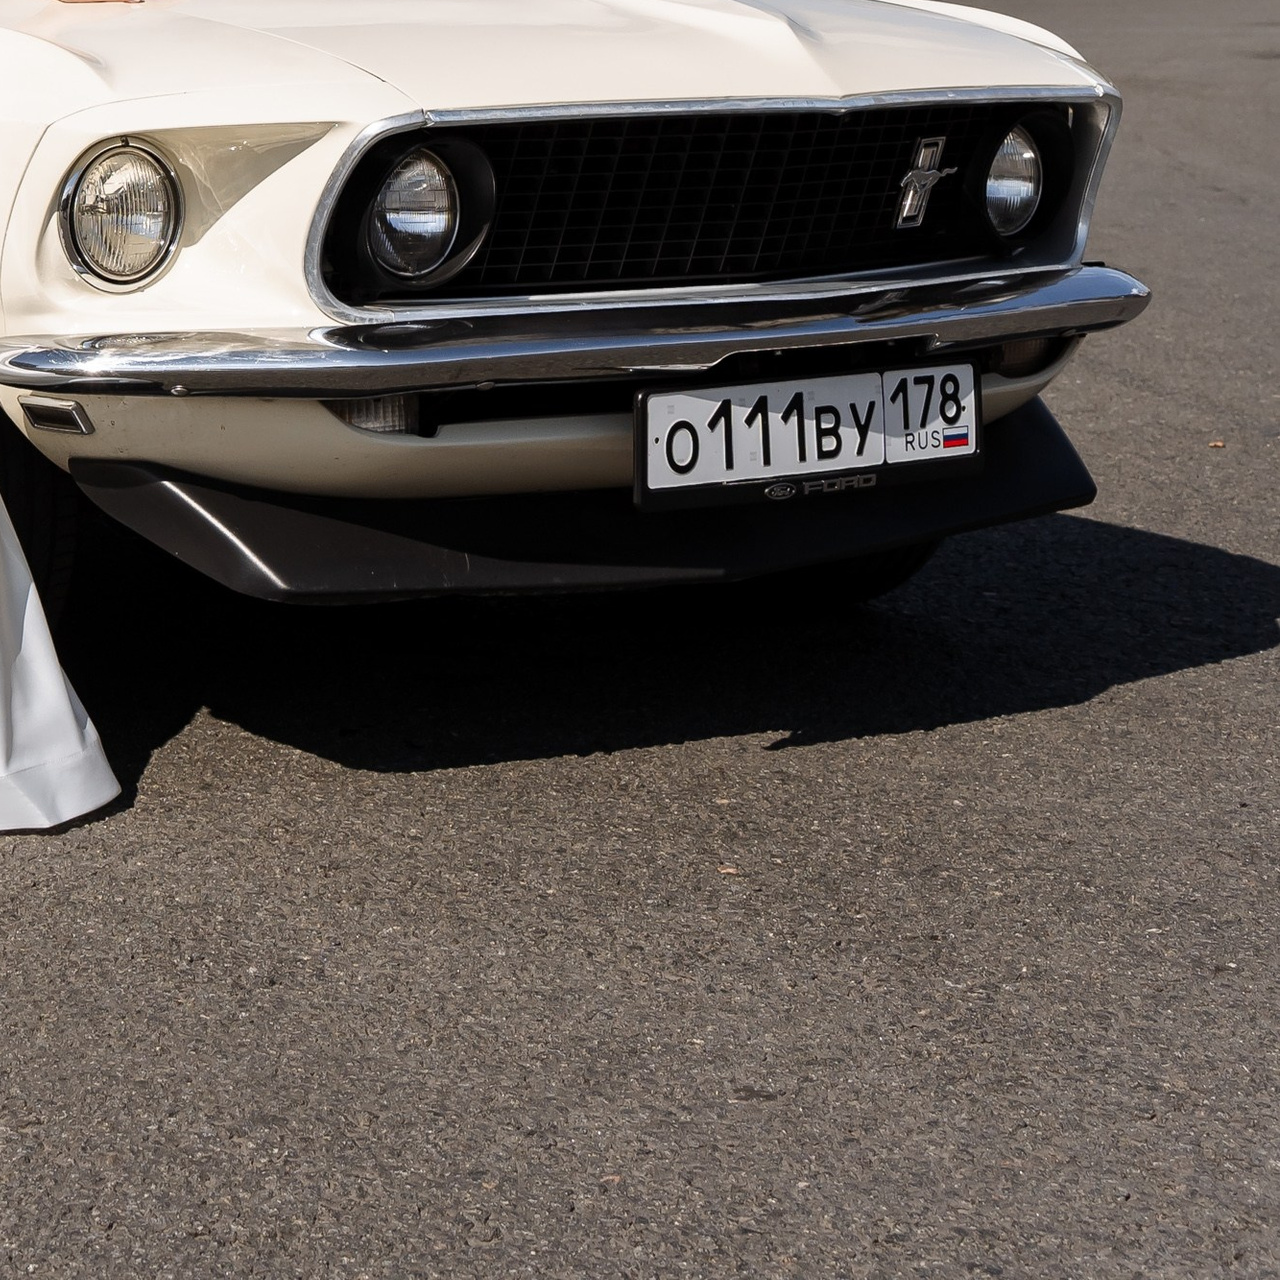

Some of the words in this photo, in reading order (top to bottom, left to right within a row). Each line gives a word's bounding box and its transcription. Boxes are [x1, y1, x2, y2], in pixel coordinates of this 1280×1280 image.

[889, 373, 962, 430] 178
[904, 430, 941, 452] RUS
[803, 474, 876, 495] FORD
